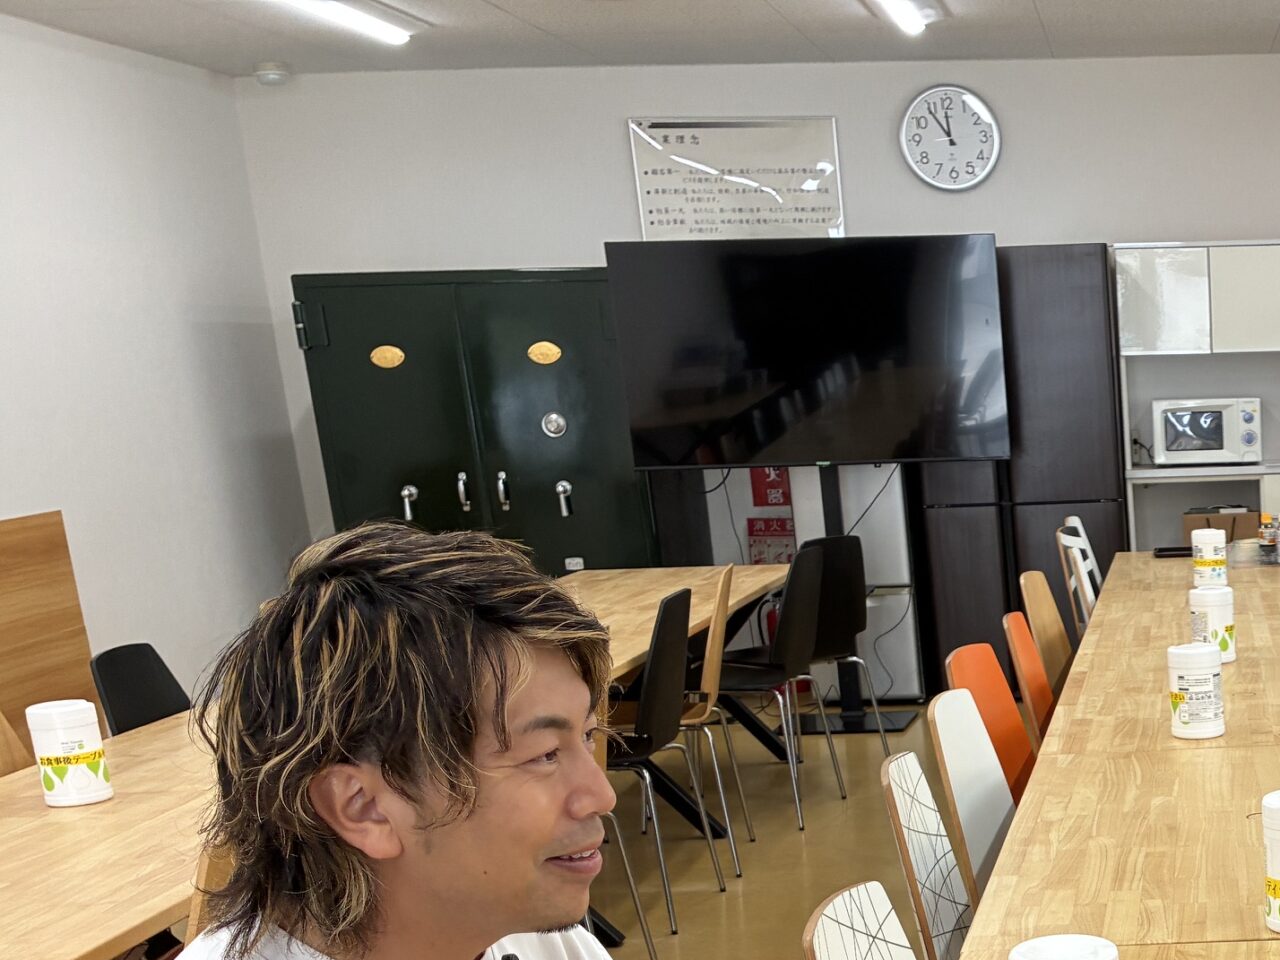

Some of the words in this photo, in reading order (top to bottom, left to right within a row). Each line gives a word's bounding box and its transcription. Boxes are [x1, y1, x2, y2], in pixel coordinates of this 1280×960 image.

[940, 96, 953, 110] 12
[913, 116, 929, 130] 10
[972, 112, 982, 126] 2
[911, 133, 922, 147] 9
[979, 130, 989, 144] 3
[920, 151, 930, 165] 8
[976, 149, 985, 161] 4
[934, 163, 944, 176] 7
[949, 166, 960, 180] 6
[965, 161, 975, 175] 5
